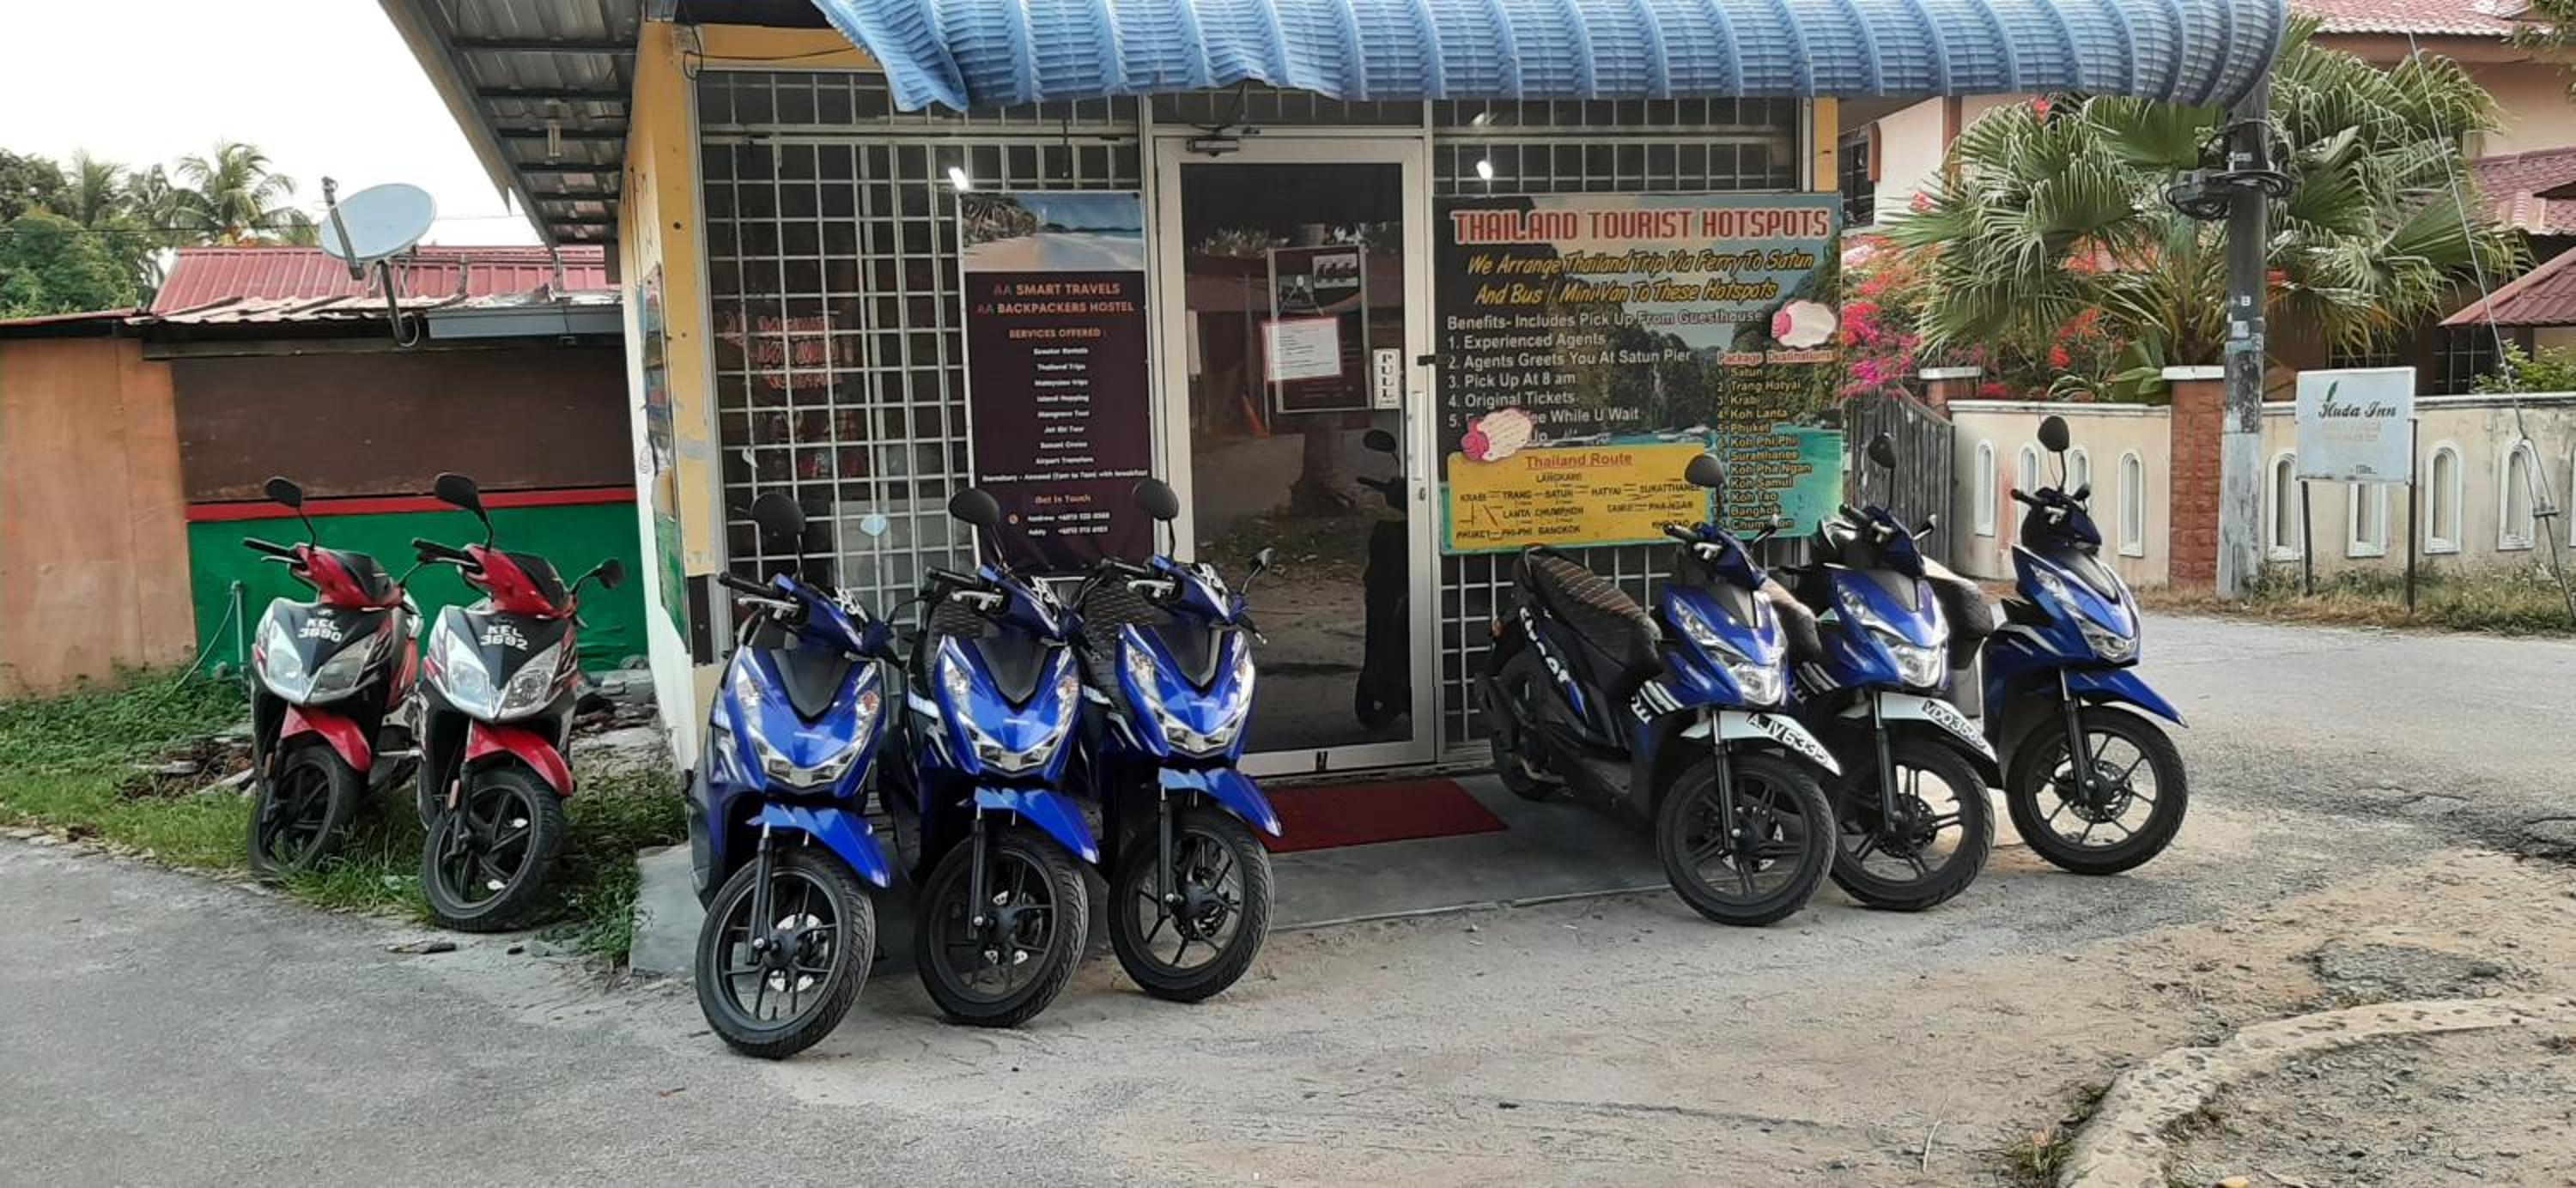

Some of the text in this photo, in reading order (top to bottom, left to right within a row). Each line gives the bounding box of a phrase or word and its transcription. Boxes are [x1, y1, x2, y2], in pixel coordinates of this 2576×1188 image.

[1452, 209, 1830, 243] THAILAND TOURIST HOTSPOTS
[1468, 248, 1815, 278] We Arrange Thailand Trip Via Ferry To Satun
[1016, 283, 1060, 296] SMART
[1064, 282, 1121, 295] TRAVELS
[1474, 282, 1510, 304] And
[1511, 283, 1544, 304] Bus
[1631, 279, 1650, 302] To
[1652, 277, 1701, 300] These
[1701, 277, 1779, 306] Hotspots
[997, 301, 1087, 314] BACKPACKERS
[1089, 300, 1134, 312] HOSTEL
[1515, 313, 1576, 328] Includes
[1579, 312, 1610, 327] Pick
[1613, 312, 1634, 329] Up
[1637, 310, 1674, 325] From
[1678, 308, 1762, 324] Guesthouse
[1009, 329, 1056, 339] SERVICES
[1464, 333, 1552, 352] Experienced
[1555, 332, 1607, 349] Agents
[1463, 355, 1515, 373] Agents
[1517, 352, 1565, 367] Greets
[1569, 351, 1596, 366] You
[1599, 351, 1615, 365] At
[1618, 349, 1661, 364] Satun
[1663, 347, 1691, 362] Pier
[1381, 352, 1395, 399] PULL
[1731, 367, 1763, 377] Satun
[1464, 373, 1496, 388] Pick
[1498, 373, 1519, 390] Up
[1522, 372, 1539, 386] At
[1541, 372, 1551, 385] 8
[1554, 373, 1577, 385] am
[1731, 380, 1763, 393] Trang
[1464, 392, 1521, 409] Original
[1549, 409, 1590, 424] While
[1594, 408, 1604, 421] U
[1607, 406, 1639, 421] Wait
[1731, 409, 1753, 420] Koh
[1757, 409, 1788, 420] Lanta
[2364, 401, 2397, 419] Inn
[1731, 436, 1753, 447] Koh
[1525, 452, 1632, 470] Thailand Route
[1730, 464, 1753, 476] Koh
[1730, 477, 1753, 489] Koh
[1730, 491, 1754, 503] Koh
[1730, 504, 1782, 518] Bangkok
[307, 617, 340, 631] KEL
[487, 624, 524, 638] KEL
